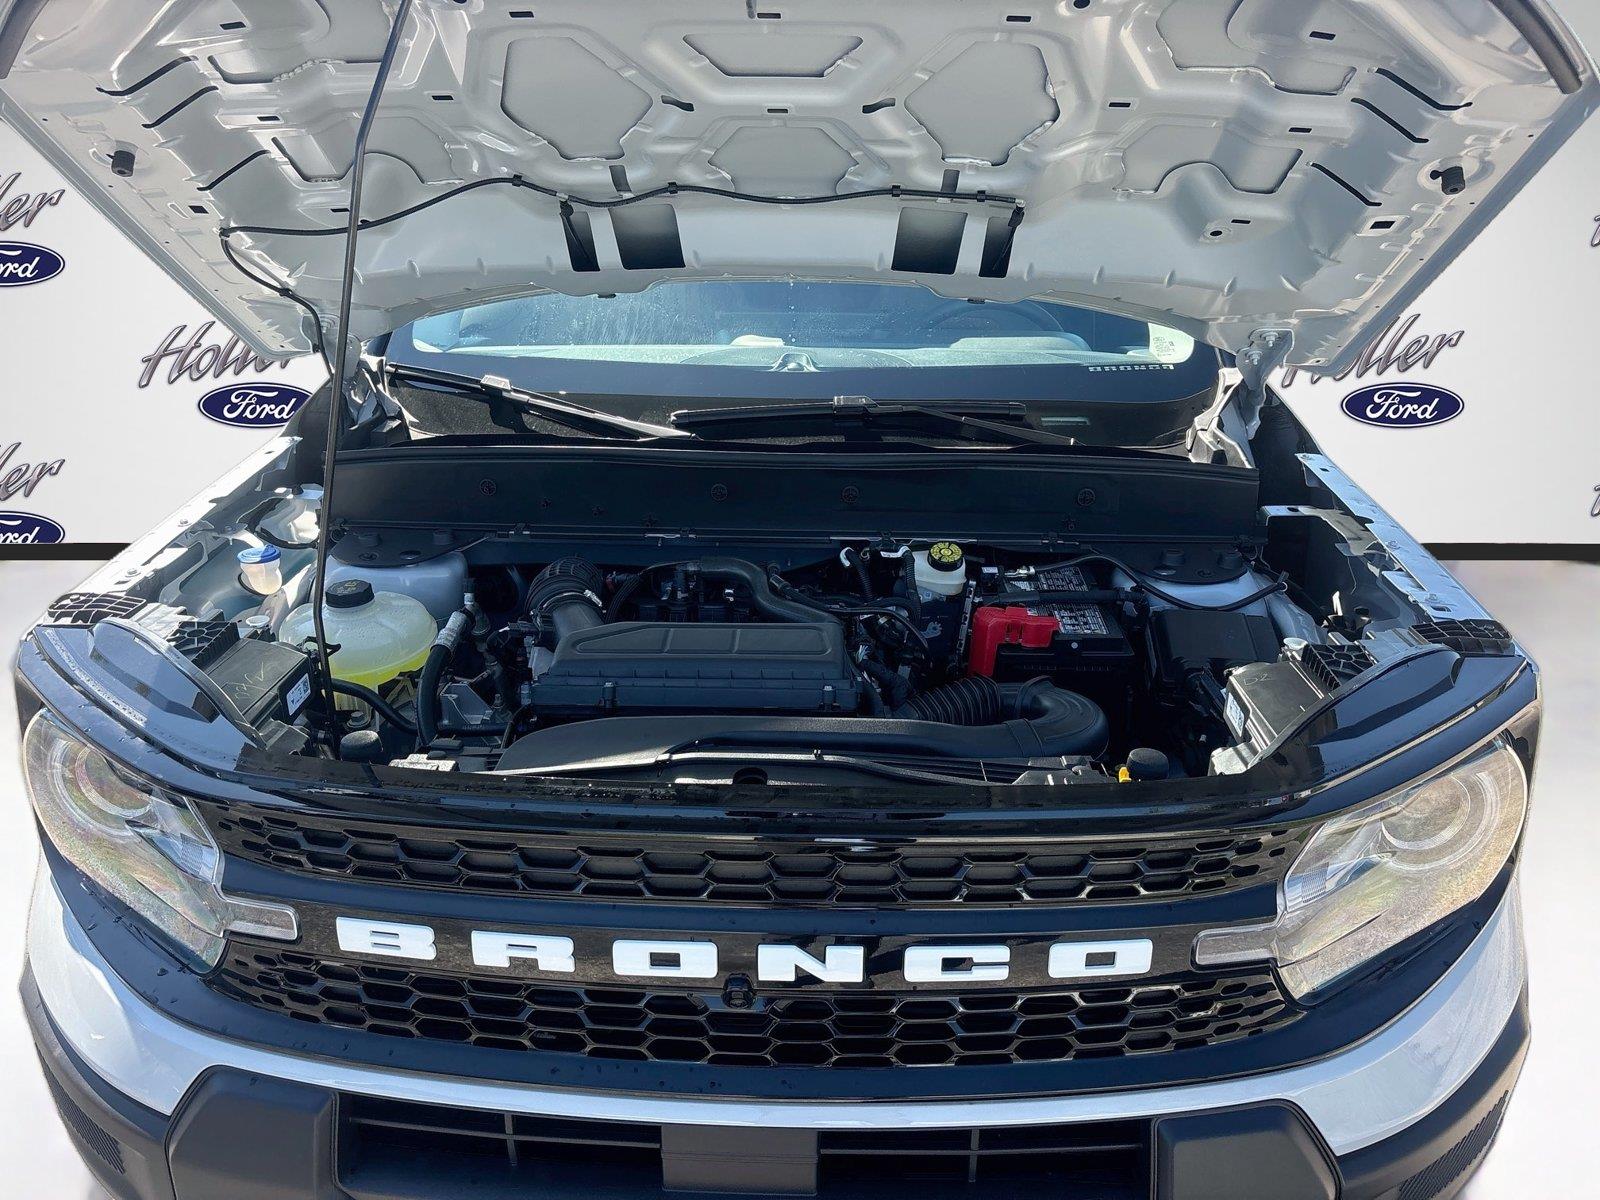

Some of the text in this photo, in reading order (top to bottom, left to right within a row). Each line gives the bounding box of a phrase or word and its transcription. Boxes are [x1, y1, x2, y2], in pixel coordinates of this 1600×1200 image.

[1281, 313, 1465, 388] ller
[223, 389, 297, 420] Ford
[1365, 389, 1440, 420] Ford
[336, 916, 1154, 983] BRONCO
